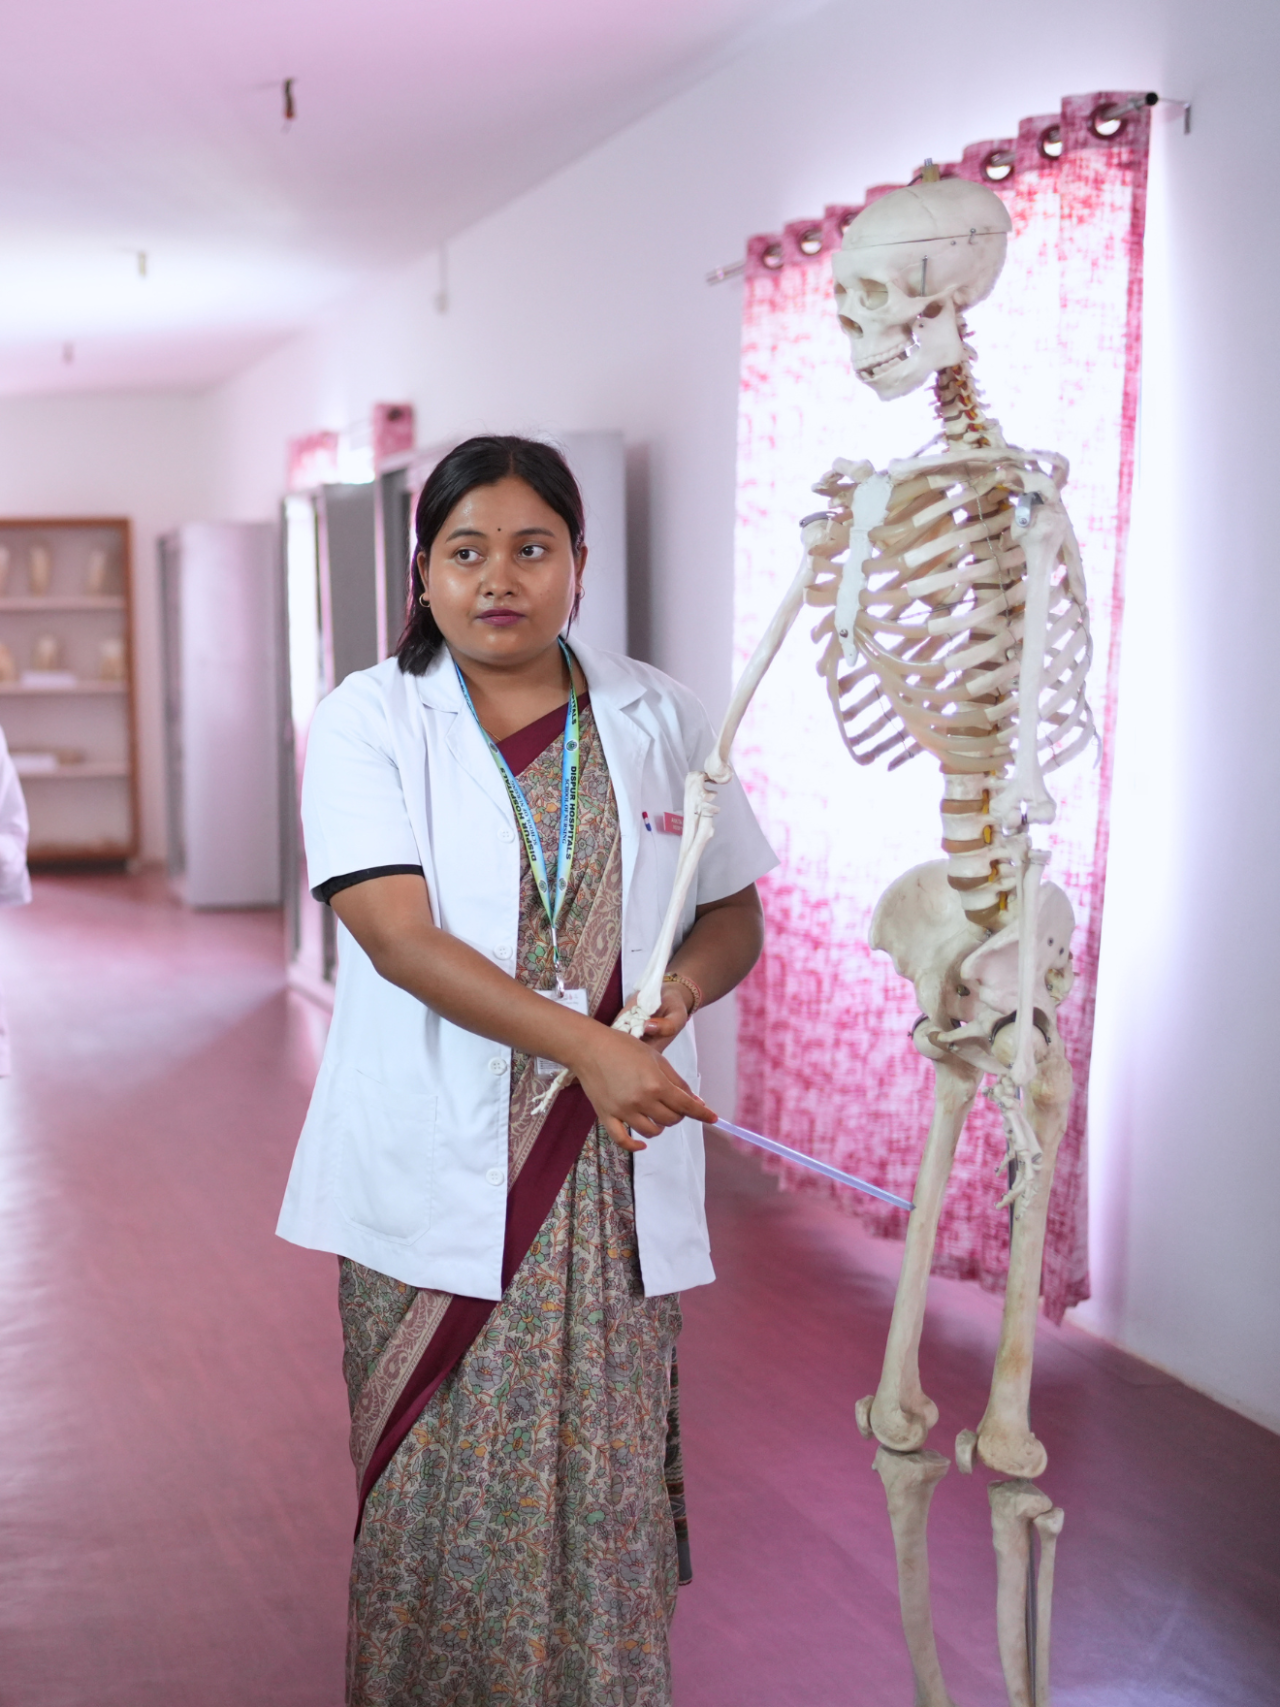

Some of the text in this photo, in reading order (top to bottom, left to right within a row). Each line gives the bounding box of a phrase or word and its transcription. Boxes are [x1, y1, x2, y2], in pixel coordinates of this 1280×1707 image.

[500, 767, 537, 862] DISPUR HOSPITALS
[511, 780, 539, 846] SCHOOL OF NURSING
[561, 814, 569, 844] NURSING
[564, 804, 569, 813] OF
[565, 803, 576, 860] HOSPITALS
